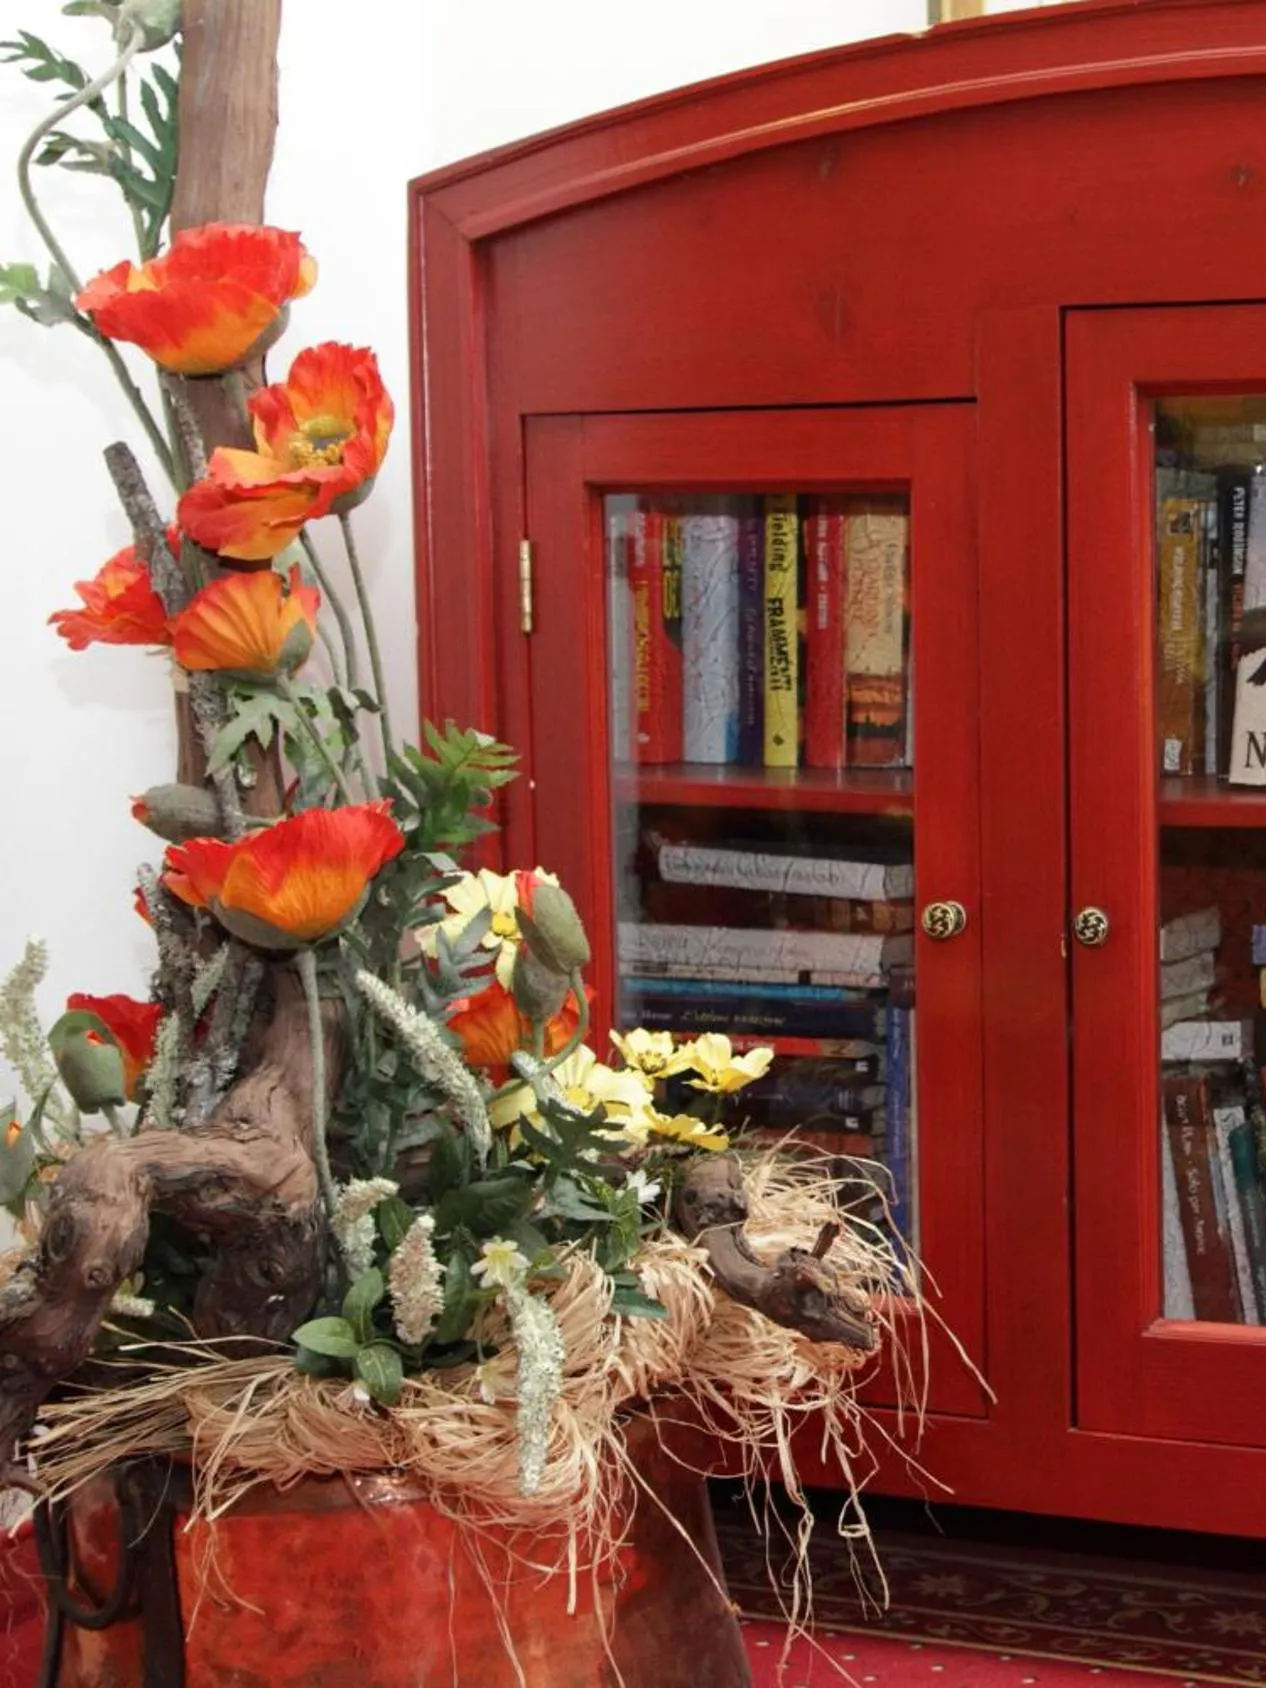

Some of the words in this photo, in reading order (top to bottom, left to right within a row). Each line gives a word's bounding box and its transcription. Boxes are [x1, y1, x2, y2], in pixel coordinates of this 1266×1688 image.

[1233, 487, 1245, 518] PETER
[1231, 522, 1245, 575] ROBINSON
[1185, 1166, 1201, 1193] Solo
